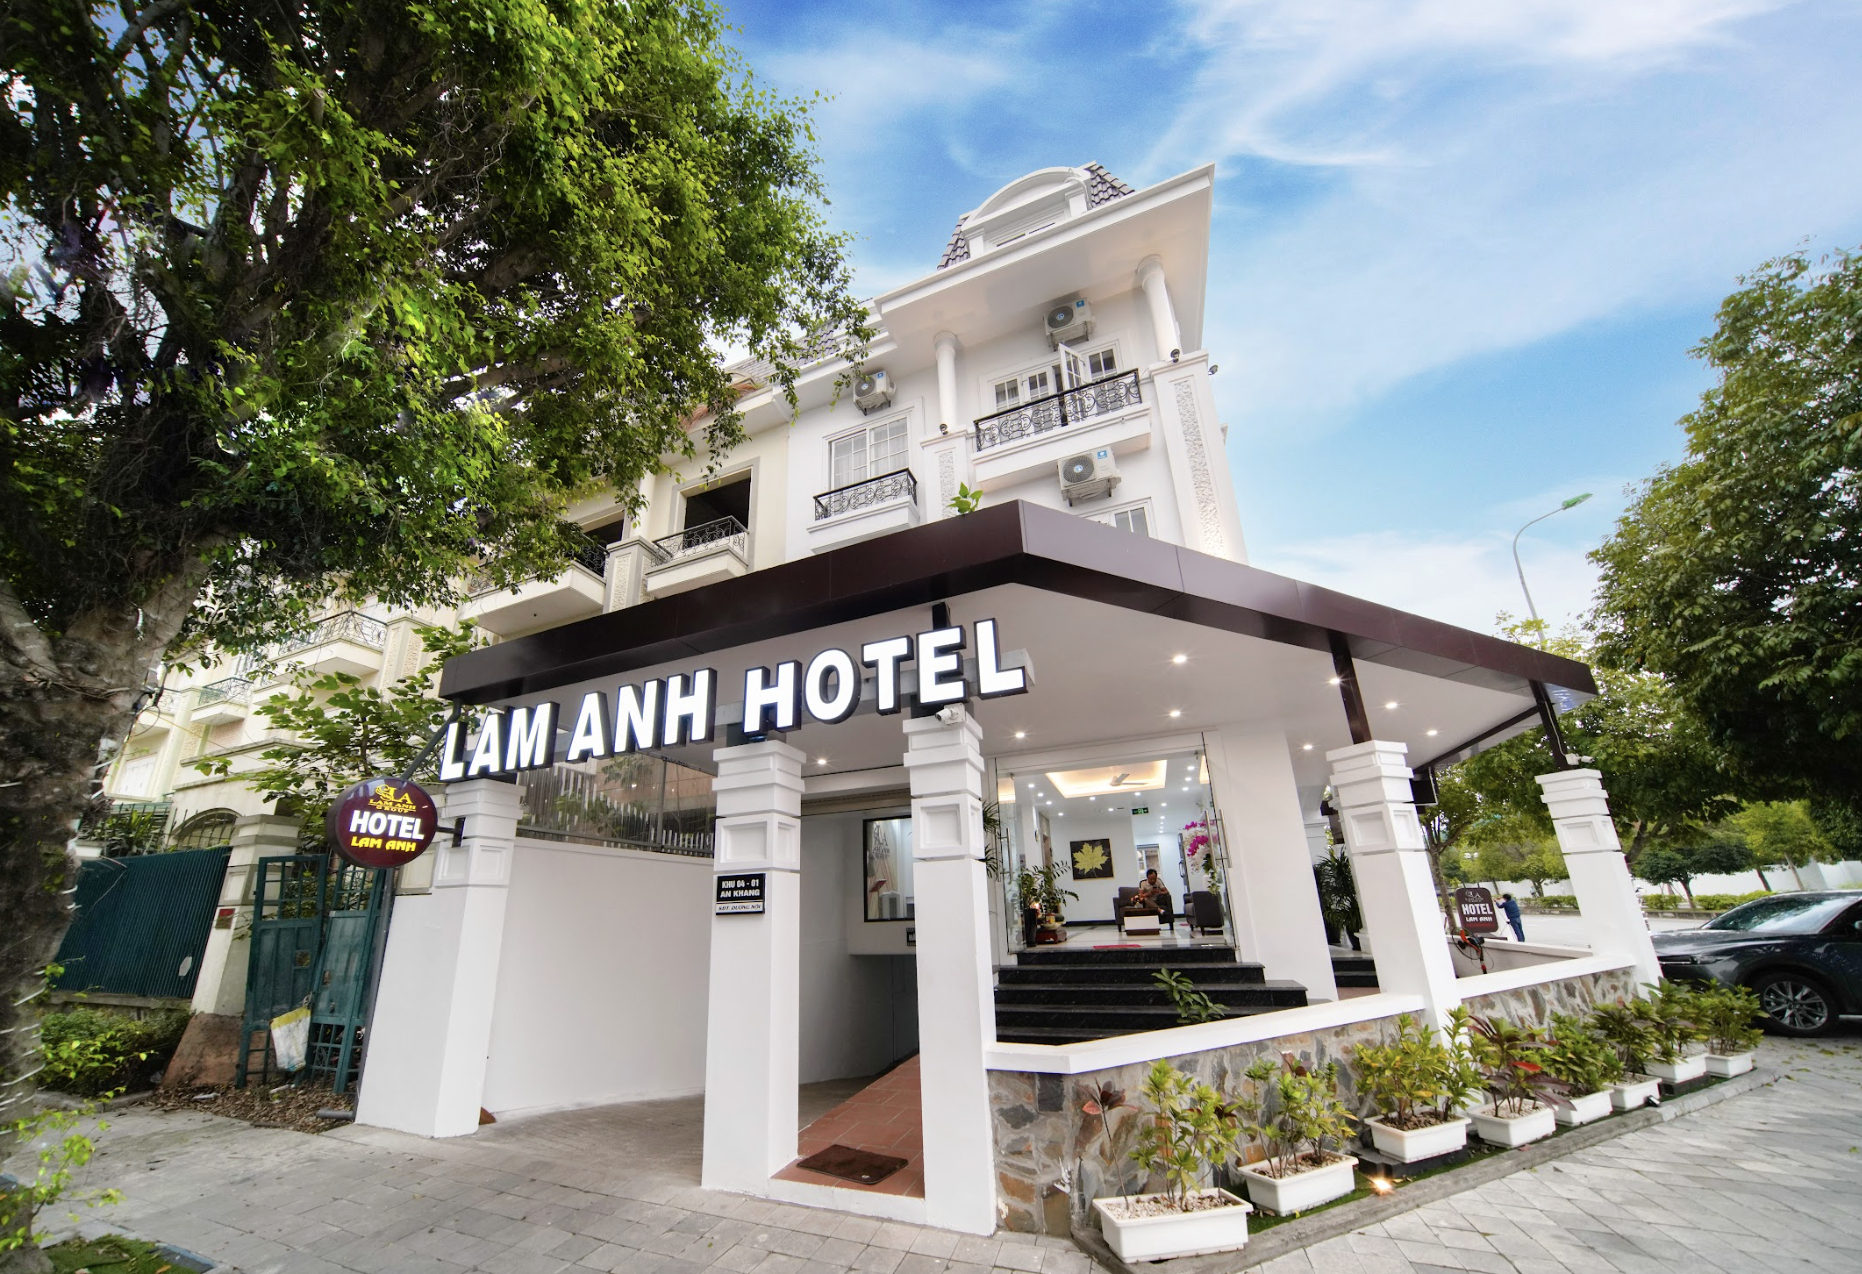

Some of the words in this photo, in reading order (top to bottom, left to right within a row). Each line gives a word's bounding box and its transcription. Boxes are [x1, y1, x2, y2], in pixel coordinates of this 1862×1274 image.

[439, 701, 560, 784] LAM
[566, 667, 718, 764] ANH
[742, 617, 1029, 737] HOTEL
[368, 799, 393, 807] LAM
[350, 810, 424, 840] HOTEL
[351, 836, 382, 848] LAM
[386, 840, 416, 852] ANH
[722, 880, 736, 888] KHU
[733, 889, 760, 897] KHANG
[1462, 904, 1493, 915] HOTEL
